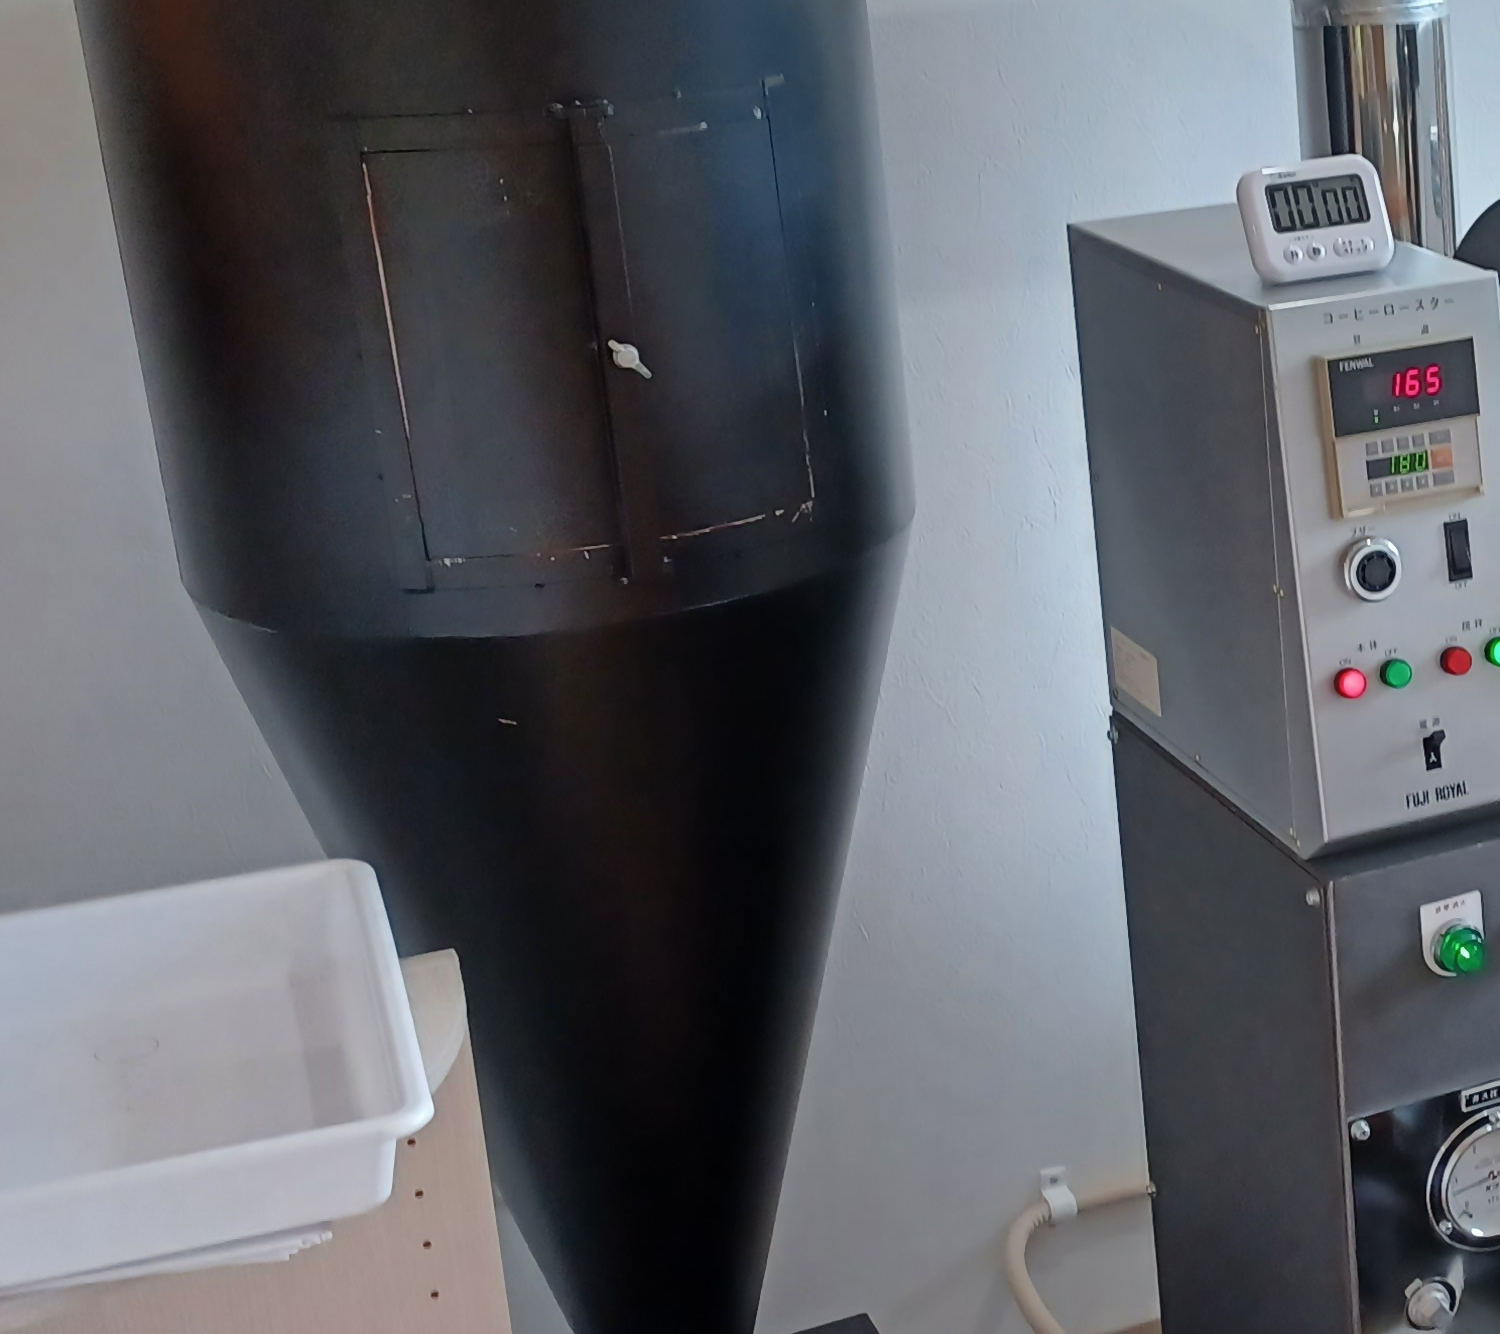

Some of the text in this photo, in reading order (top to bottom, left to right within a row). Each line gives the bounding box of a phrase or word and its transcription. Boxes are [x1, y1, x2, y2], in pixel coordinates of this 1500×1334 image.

[1394, 365, 1441, 397] 165
[1391, 451, 1426, 474] 180
[1406, 780, 1469, 810] FUJI ROYAL
